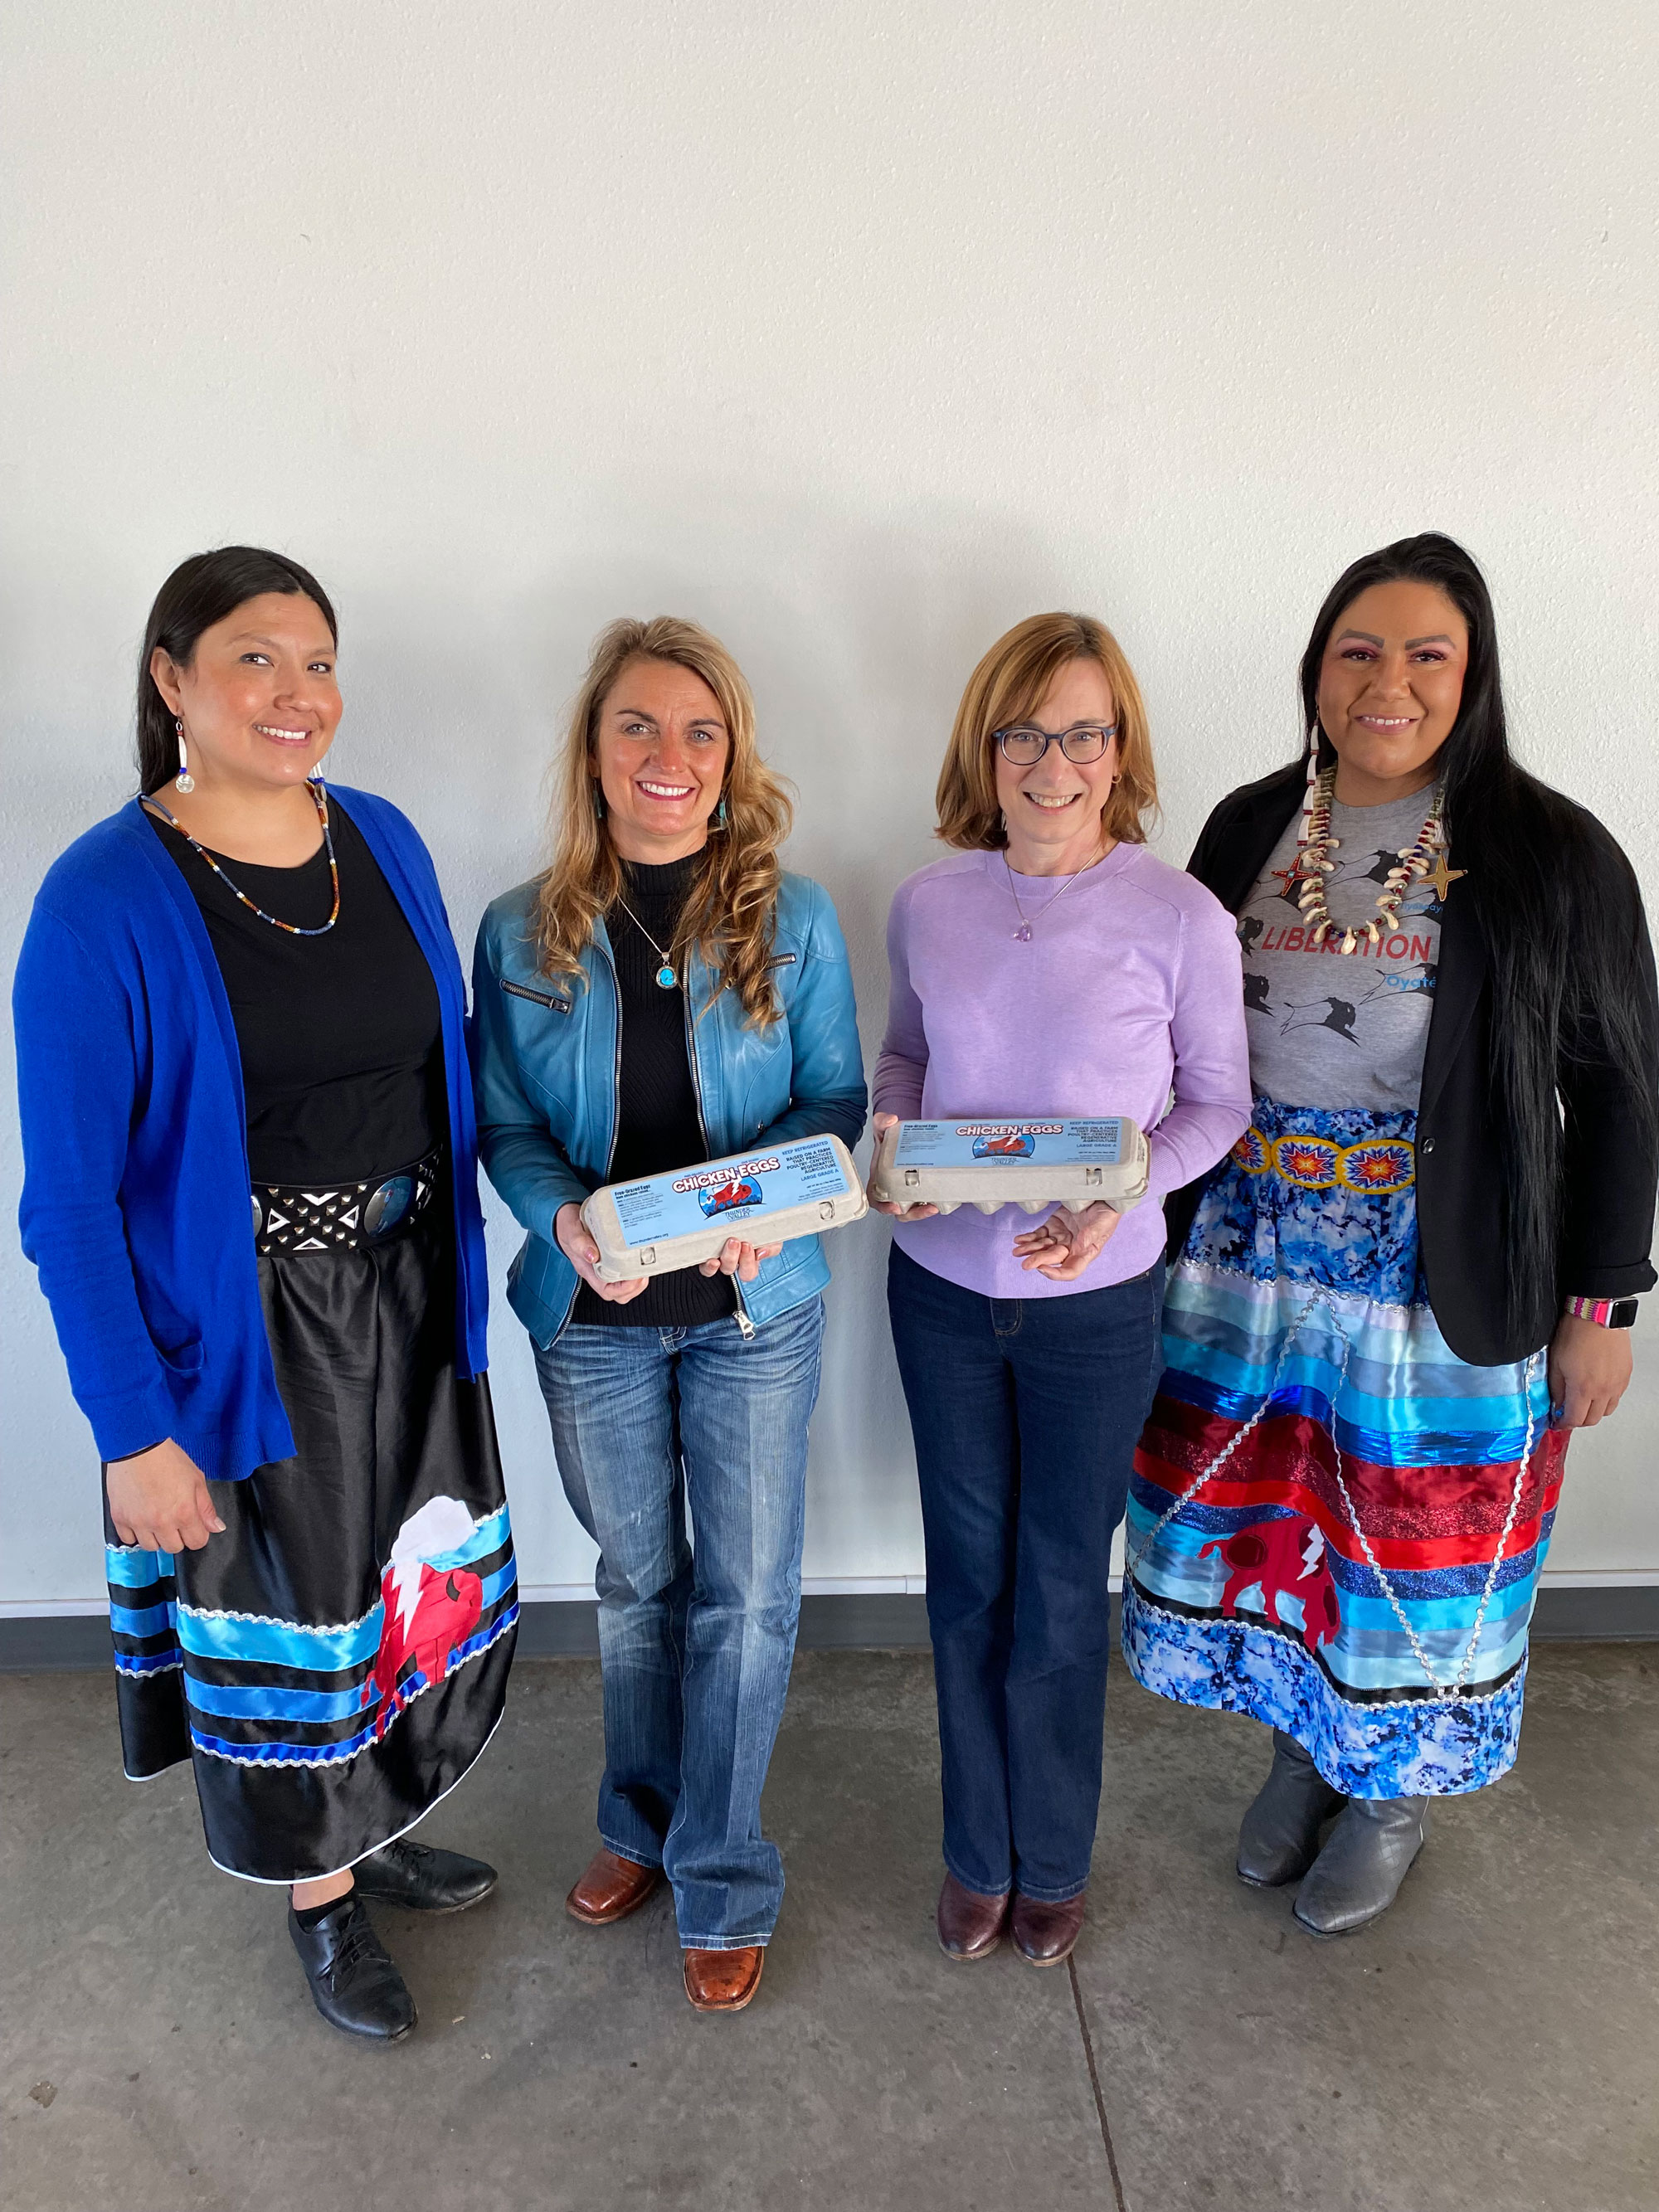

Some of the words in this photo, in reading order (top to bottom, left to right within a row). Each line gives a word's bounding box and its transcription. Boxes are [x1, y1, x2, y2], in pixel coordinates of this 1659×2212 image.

[956, 1125, 1019, 1136] CHICKEN
[1021, 1125, 1063, 1135] EGGS
[795, 1141, 828, 1152] REFRIGERATED
[806, 1151, 832, 1161] PRACTICES
[786, 1155, 833, 1169] POULTRY-CENTERED
[801, 1159, 834, 1170] REGENERATIVE
[805, 1163, 836, 1174] AGRICULTURE
[672, 1167, 737, 1193] CHICKEN
[737, 1157, 781, 1178] EGGS
[615, 1186, 640, 1196] Free-Grazed
[724, 1207, 750, 1217] THUNDER
[727, 1210, 751, 1220] VALLEY
